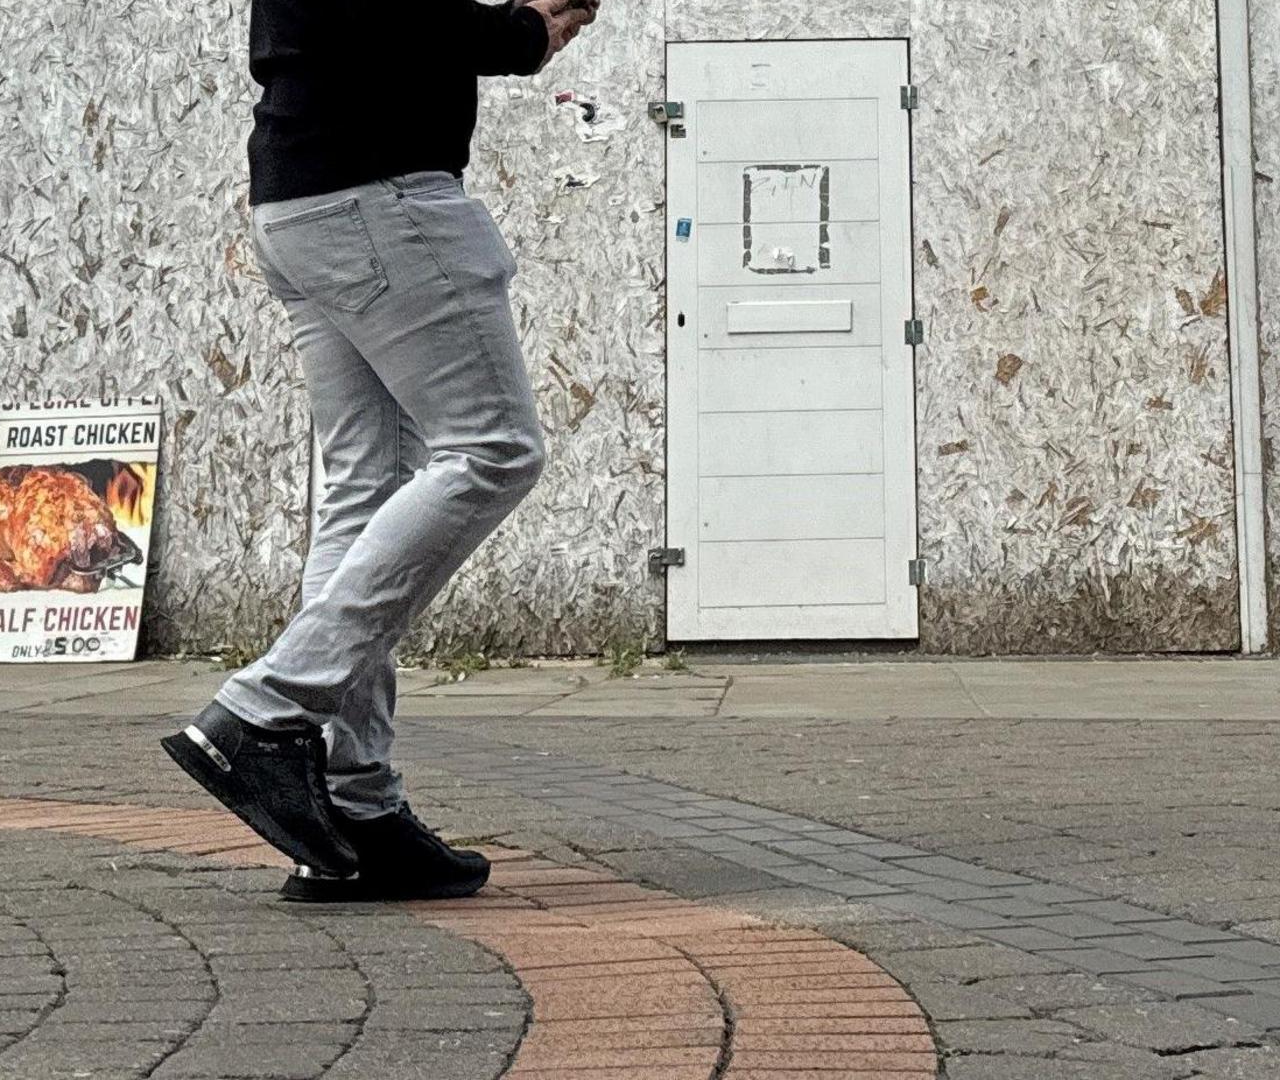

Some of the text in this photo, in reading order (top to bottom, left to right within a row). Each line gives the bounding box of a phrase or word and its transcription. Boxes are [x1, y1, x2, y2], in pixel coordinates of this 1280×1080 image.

[7, 422, 156, 448] ROAST CHICKEN
[44, 606, 138, 631] CHICKEN
